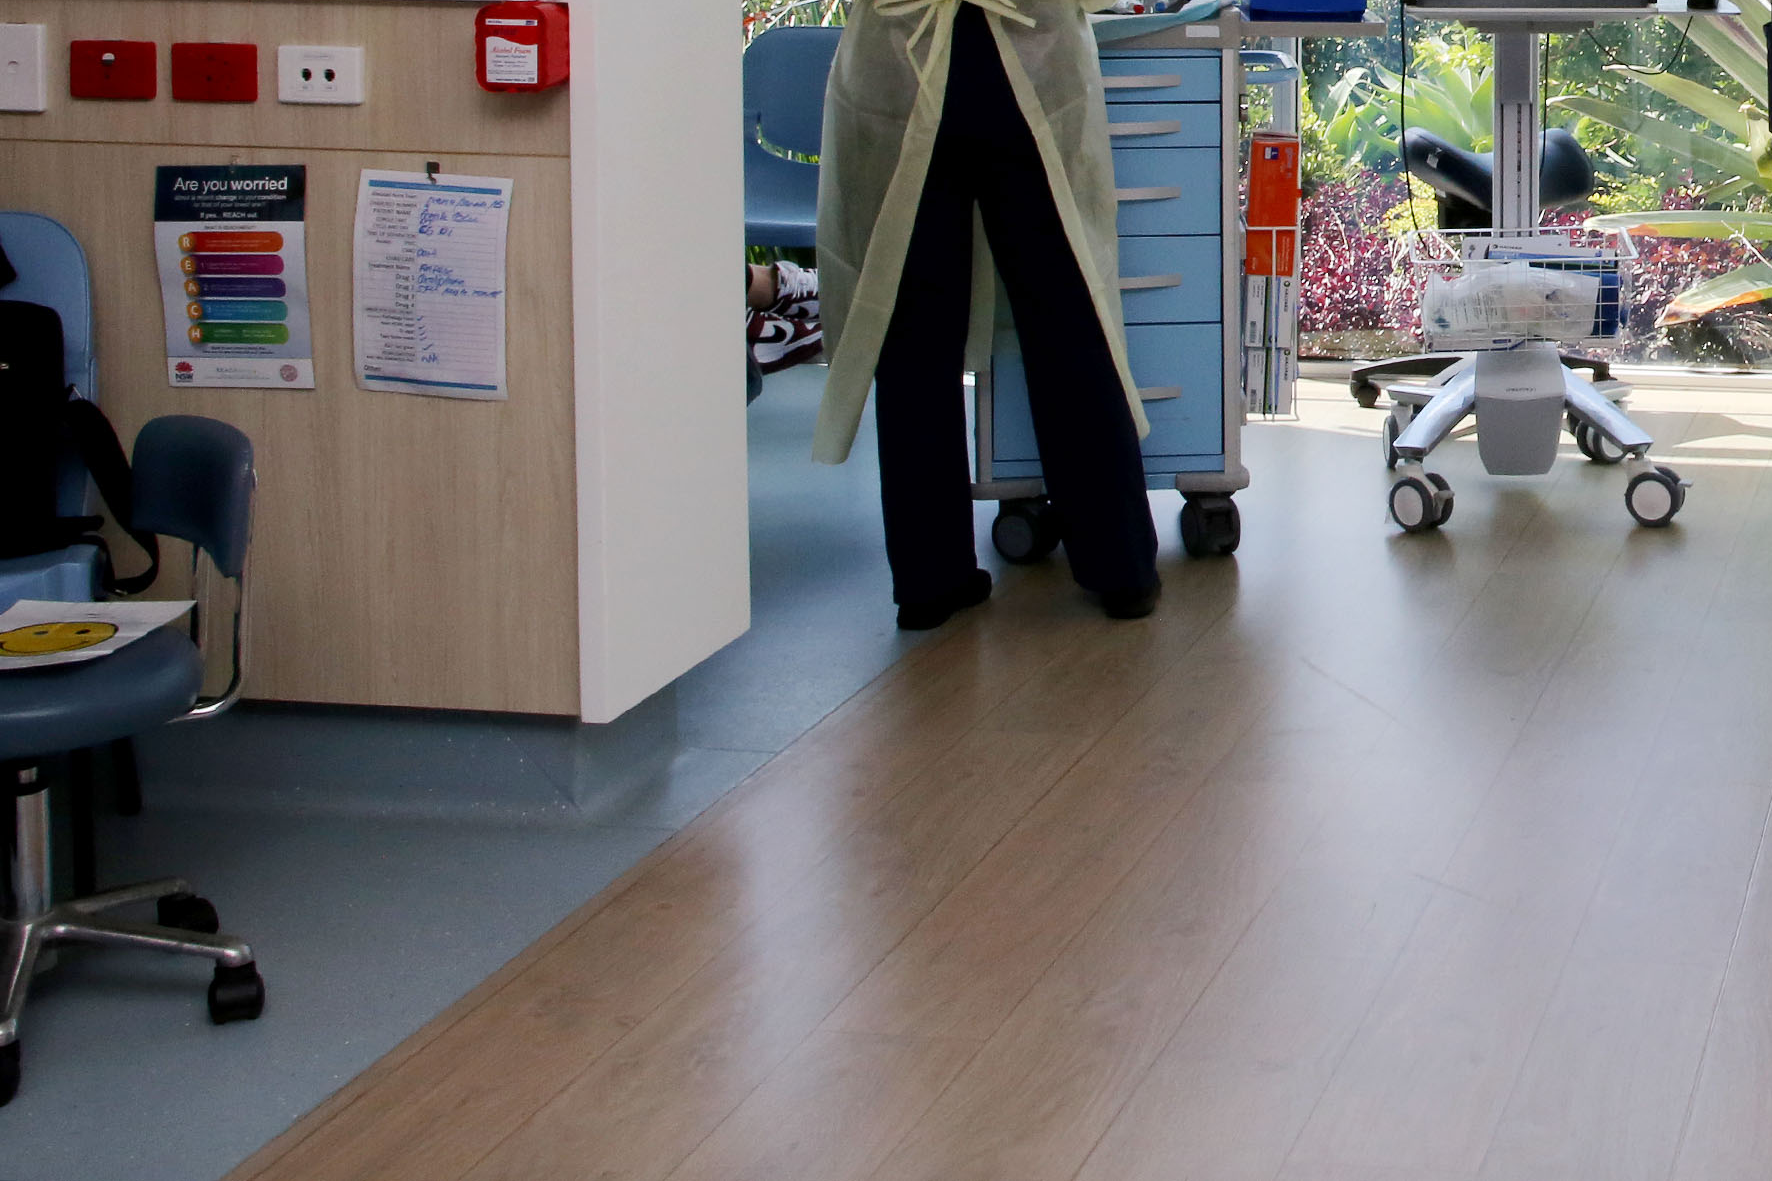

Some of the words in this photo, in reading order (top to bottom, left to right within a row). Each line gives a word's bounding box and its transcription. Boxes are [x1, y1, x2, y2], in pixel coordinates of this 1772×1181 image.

[174, 177, 199, 191] Are
[202, 180, 228, 195] you
[230, 177, 288, 191] worried
[183, 237, 190, 248] R
[185, 260, 192, 270] E
[395, 273, 410, 281] Drug
[187, 282, 197, 292] A
[395, 283, 410, 291] Drug
[395, 292, 410, 300] Drug
[191, 306, 199, 316] C
[192, 329, 200, 338] H
